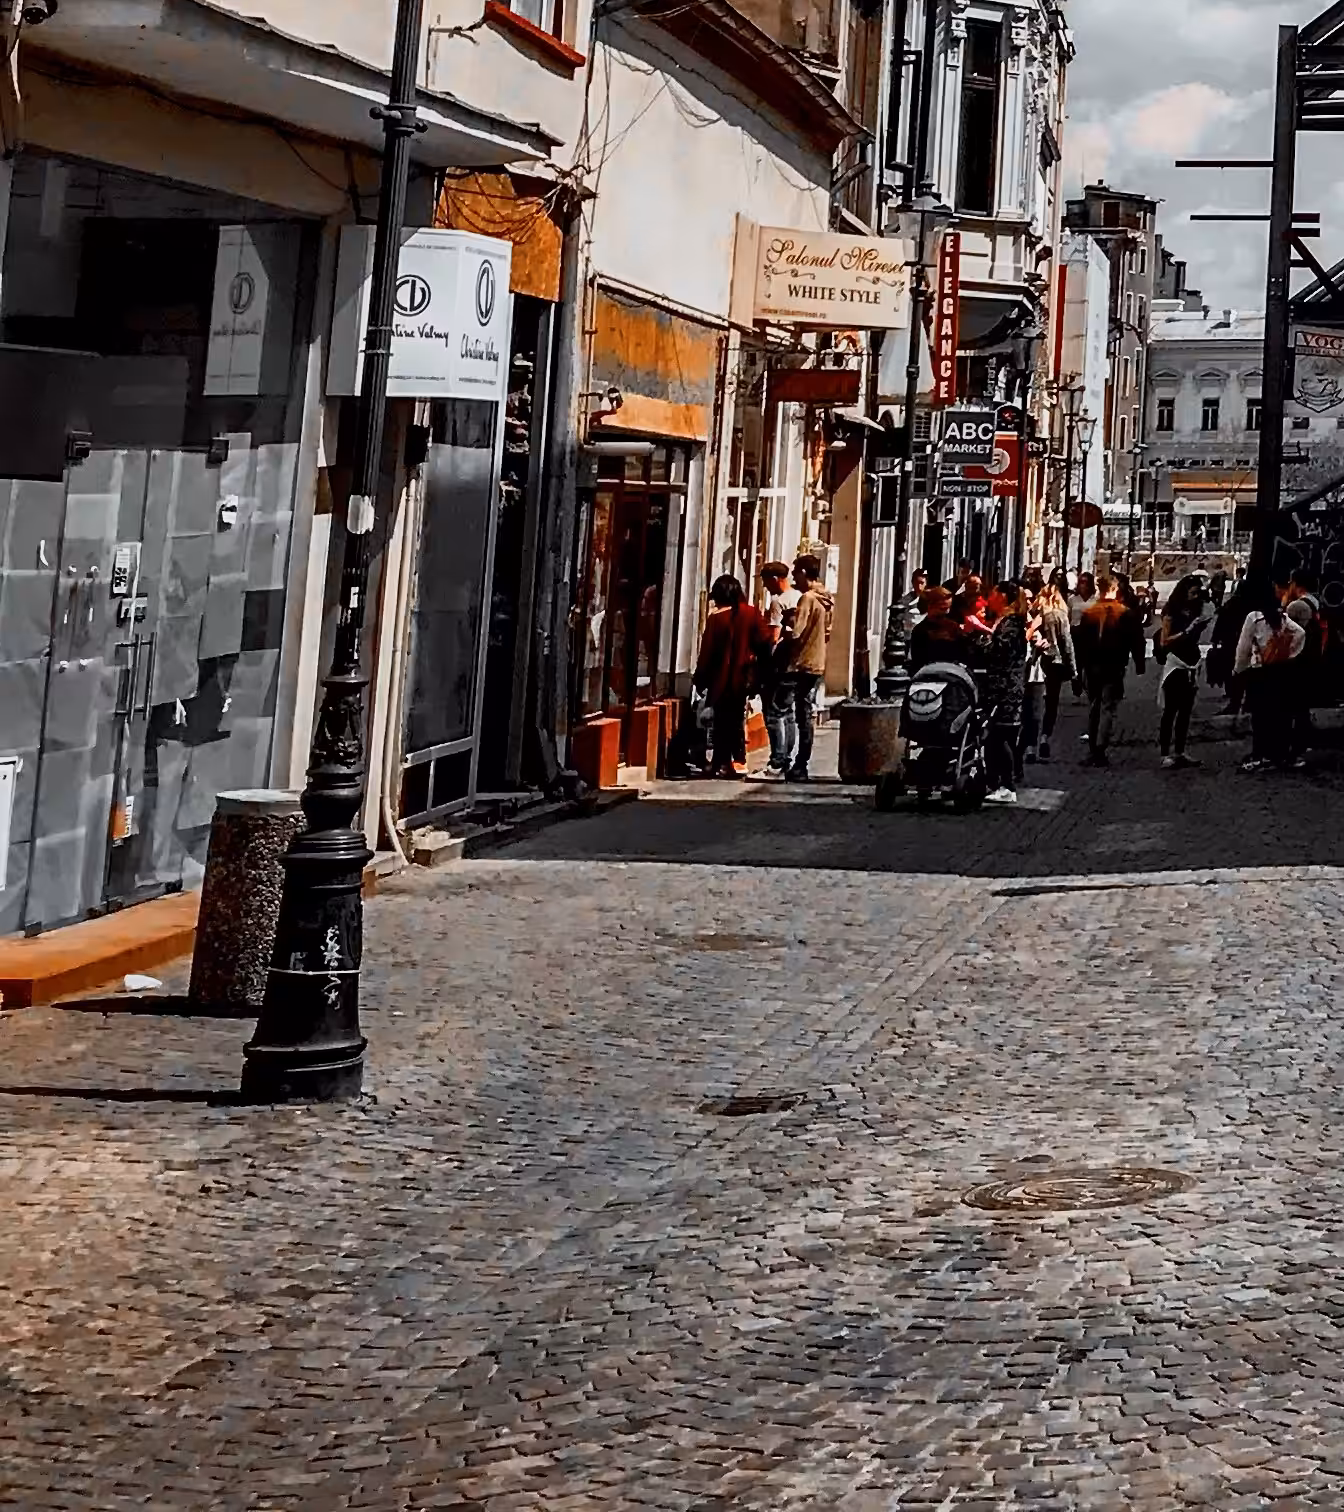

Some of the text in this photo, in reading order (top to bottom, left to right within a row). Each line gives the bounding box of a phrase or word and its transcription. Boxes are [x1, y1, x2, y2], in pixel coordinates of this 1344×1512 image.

[766, 238, 841, 269] Salonul
[788, 283, 881, 304] WHITE STYLE
[939, 235, 955, 399] ELEGANCE
[1302, 333, 1344, 349] VOG
[945, 422, 994, 440] ABC
[943, 442, 992, 455] MARKET
